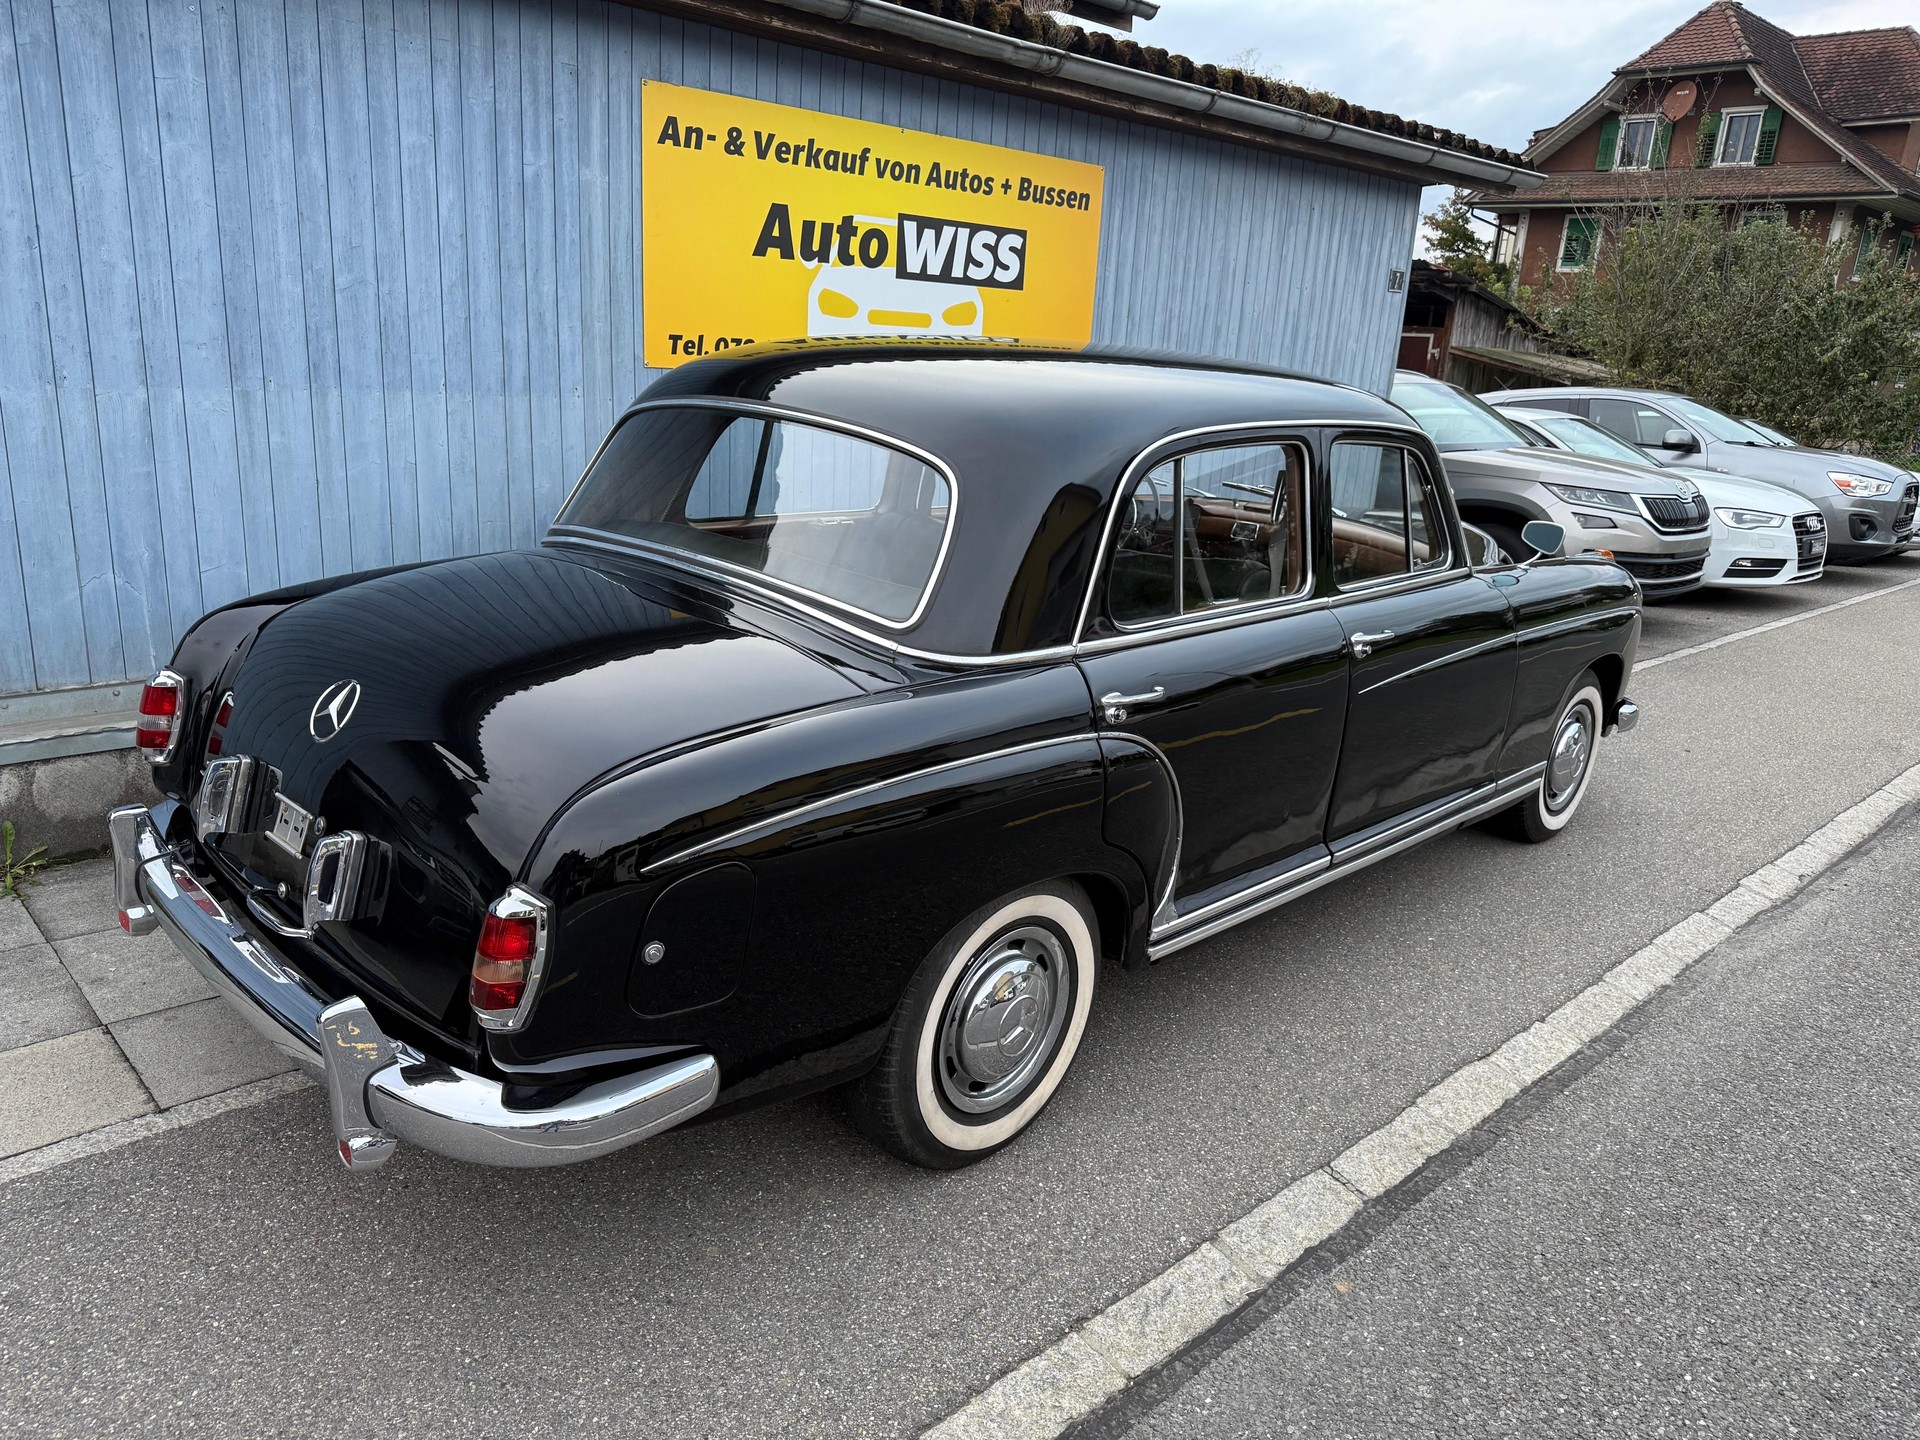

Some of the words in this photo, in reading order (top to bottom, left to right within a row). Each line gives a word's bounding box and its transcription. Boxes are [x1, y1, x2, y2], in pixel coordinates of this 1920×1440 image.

[656, 115, 717, 150] An-
[723, 126, 746, 157] &
[753, 130, 872, 176] Verkauf
[875, 157, 921, 184] von
[925, 161, 995, 196] Autos
[1000, 178, 1012, 195] +
[1017, 176, 1091, 212] Bussen
[752, 202, 889, 269] Auto
[902, 219, 1025, 283] WISS
[668, 334, 710, 356] Tel.
